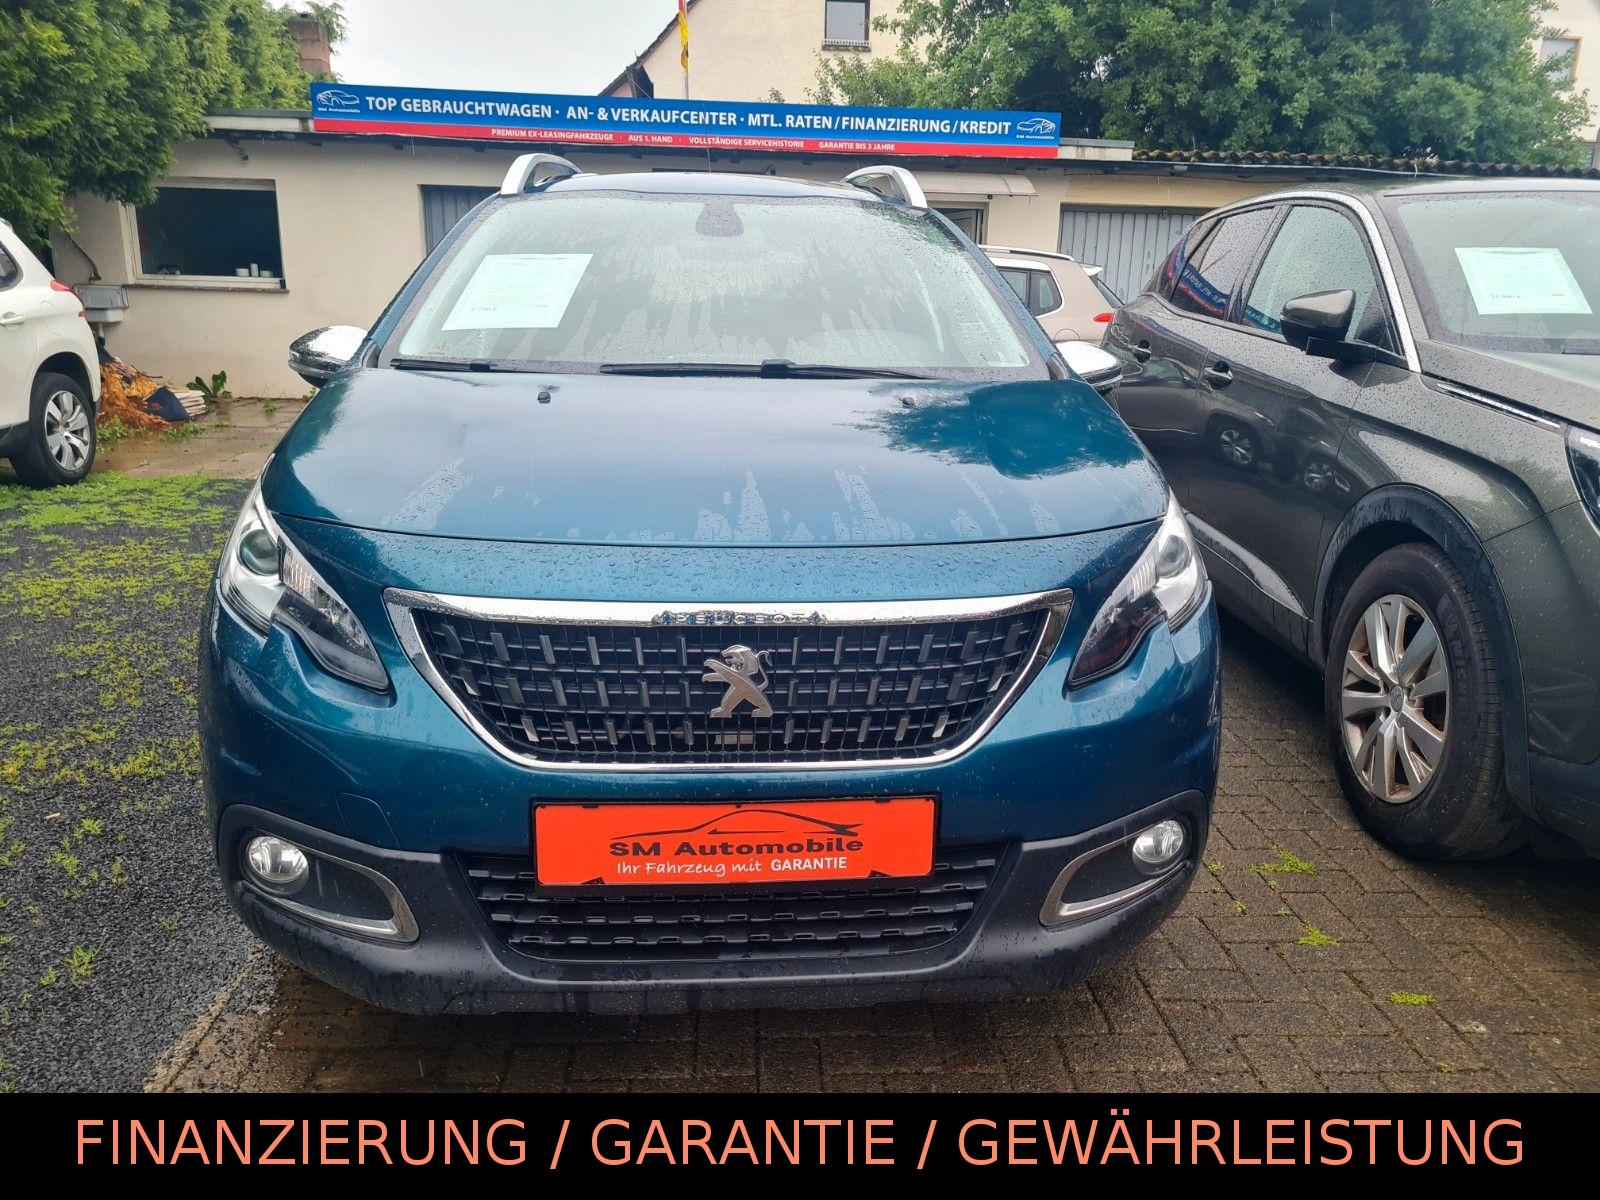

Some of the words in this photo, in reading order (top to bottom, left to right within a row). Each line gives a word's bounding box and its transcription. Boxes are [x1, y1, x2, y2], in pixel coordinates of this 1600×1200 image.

[365, 96, 398, 111] TOP
[400, 98, 552, 118] GEBRAUCHTWAGEN
[566, 106, 594, 120] AN-
[597, 107, 609, 121] &
[610, 107, 738, 126] VERKAUFCENTER
[748, 113, 783, 128] MTL.
[491, 128, 527, 138] PREMIUM
[528, 130, 614, 141] EX-LEASINGFAHRZEUGE
[628, 134, 643, 143] AUS
[689, 136, 743, 146] VOLLSTÄNDIGE
[743, 139, 804, 148] SERVICEHISTORIE
[818, 141, 854, 150] GARANTIE
[855, 142, 867, 150] BIS
[872, 143, 896, 151] JAHRE
[609, 841, 661, 856] SM
[674, 837, 864, 856] Automobile
[617, 862, 641, 874] Ihr
[645, 861, 727, 877] Fahrzeug
[732, 861, 763, 873] mit
[770, 856, 848, 872] GARANTIE
